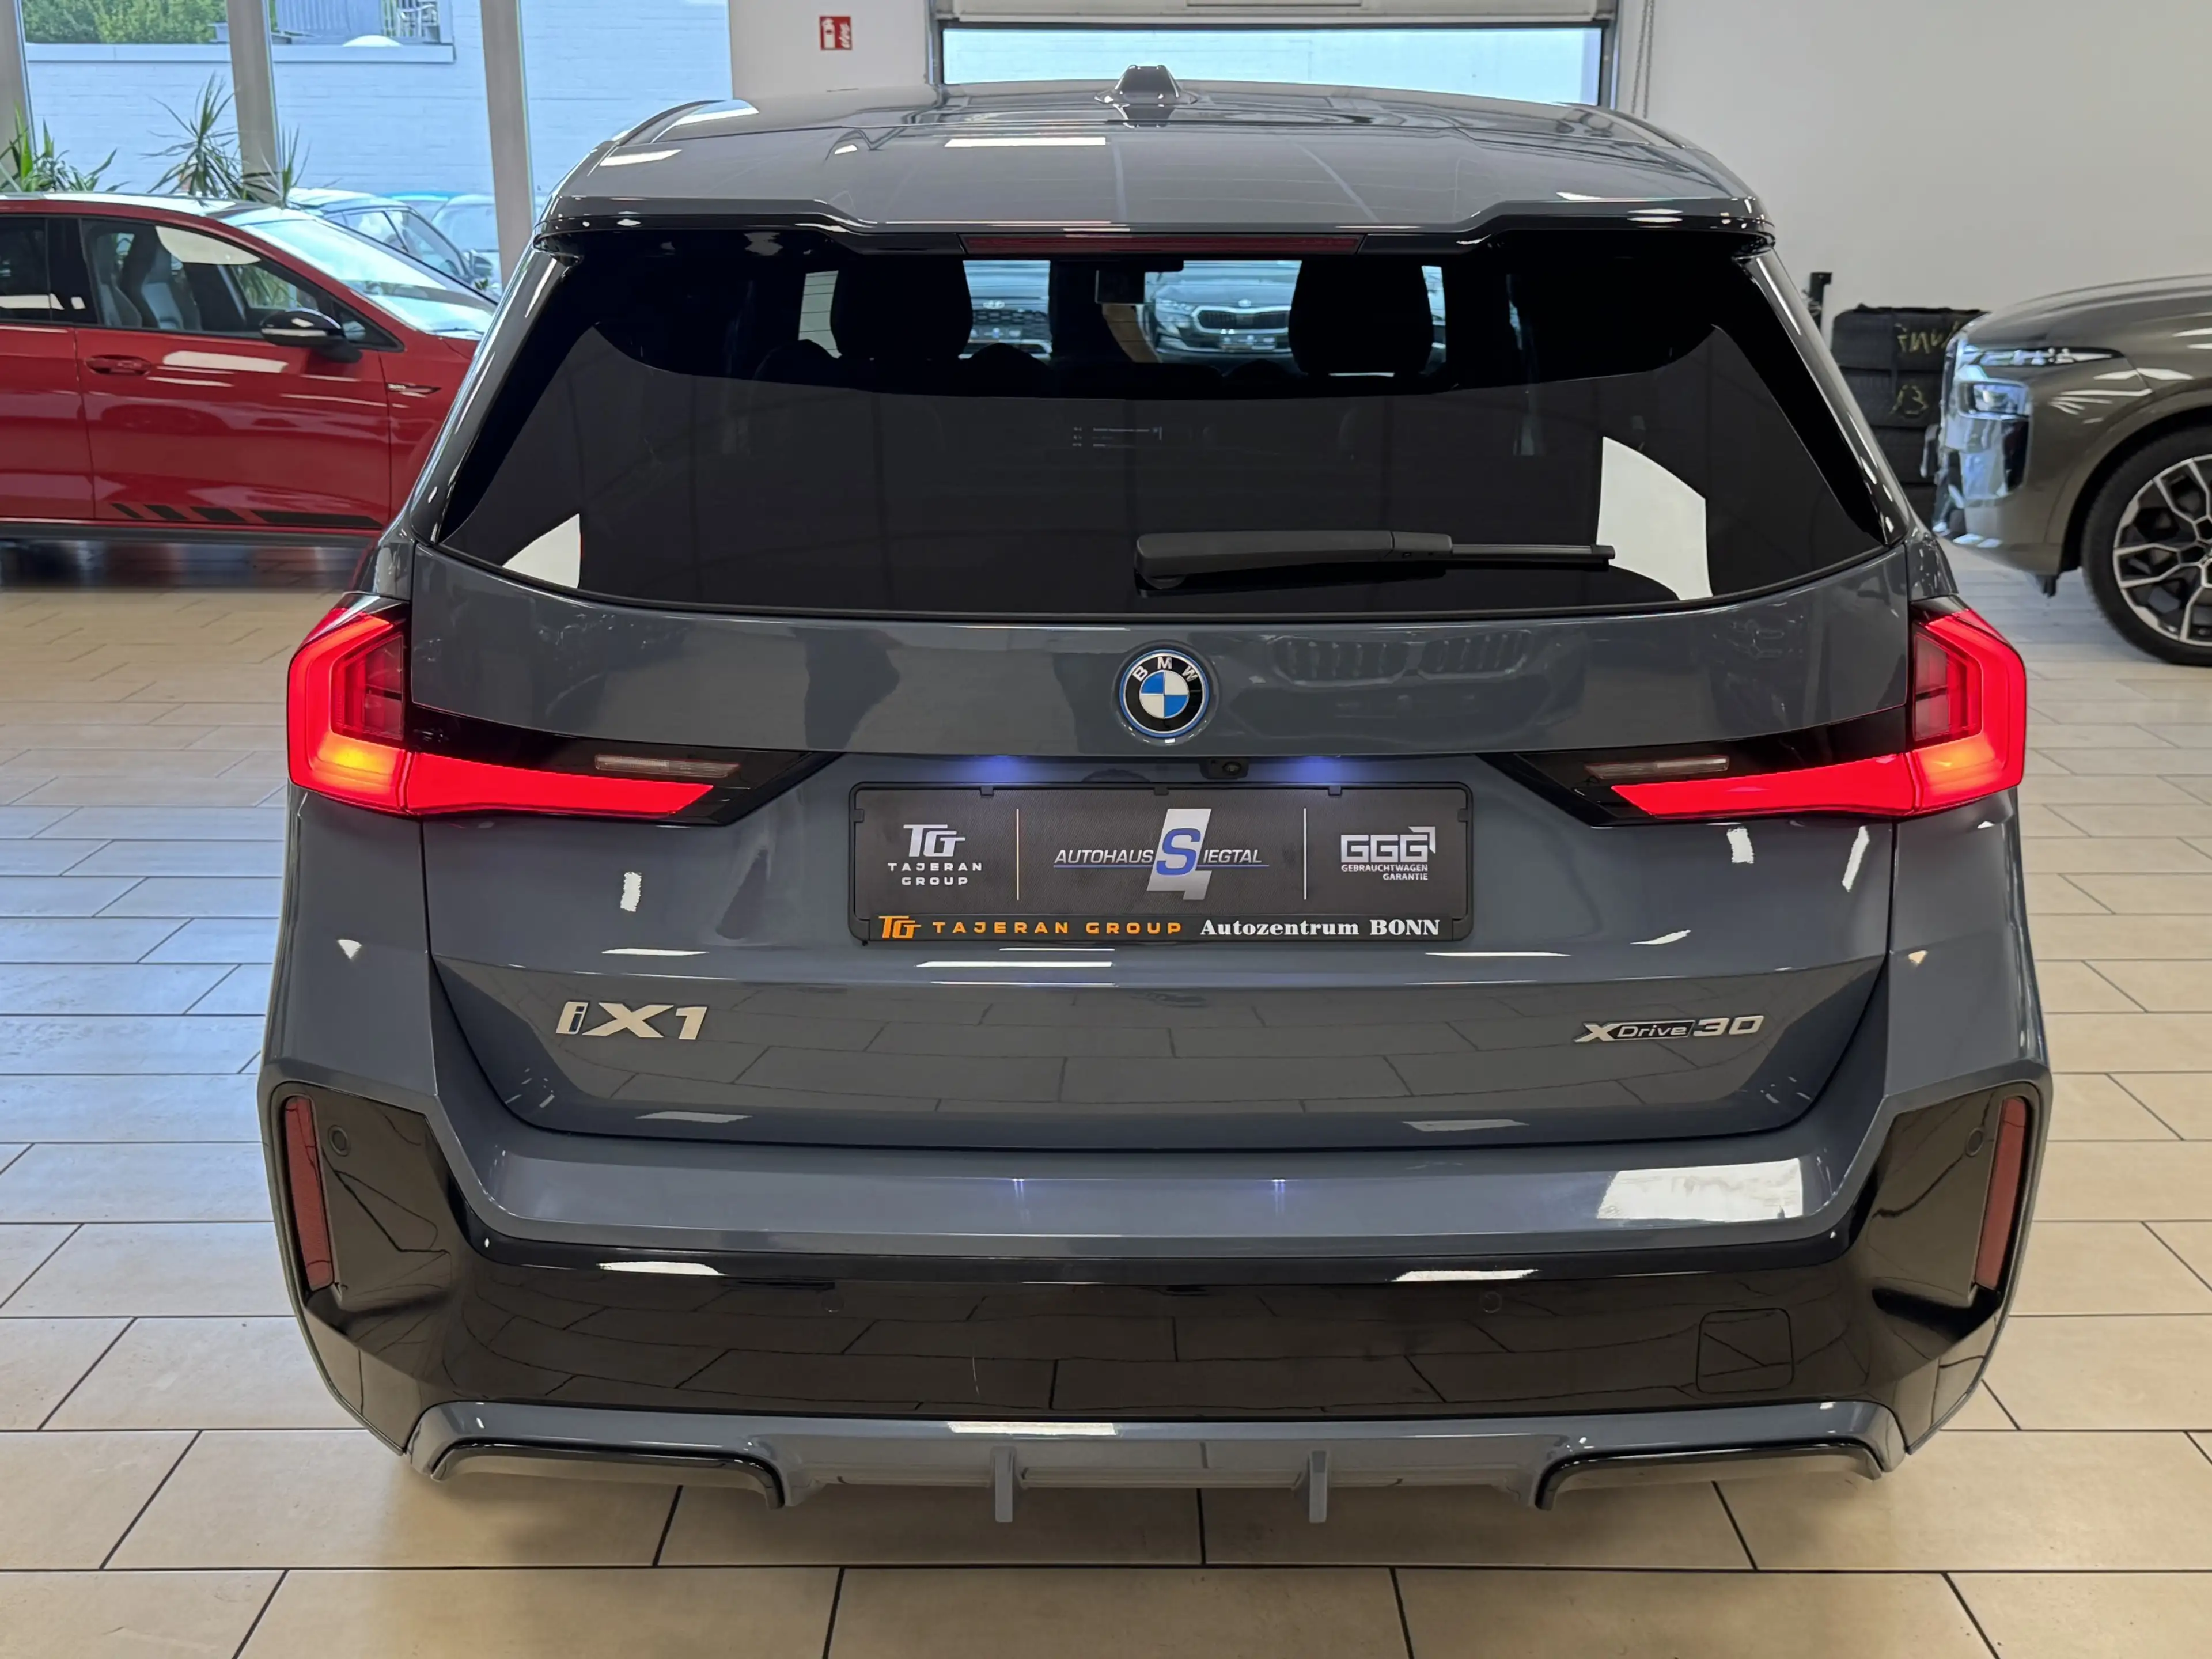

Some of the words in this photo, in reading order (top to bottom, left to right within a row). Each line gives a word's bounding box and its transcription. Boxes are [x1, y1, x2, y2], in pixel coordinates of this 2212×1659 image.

[1132, 656, 1198, 682] BMW
[903, 824, 965, 857] TG
[1340, 834, 1428, 863] GGG
[1054, 849, 1154, 864] AUTOHAUS
[887, 862, 982, 872] TAJERAN
[1341, 864, 1428, 872] GEBRAUCHTWAGEN
[902, 877, 968, 886] GROUP
[1382, 873, 1429, 881] GARANTIE
[878, 915, 921, 938] TG
[933, 922, 1068, 934] TAJERAN
[1086, 922, 1181, 934] GROUP
[1200, 919, 1359, 935] Autozentrum
[1369, 919, 1440, 935] BONN
[555, 1001, 708, 1040] iX1
